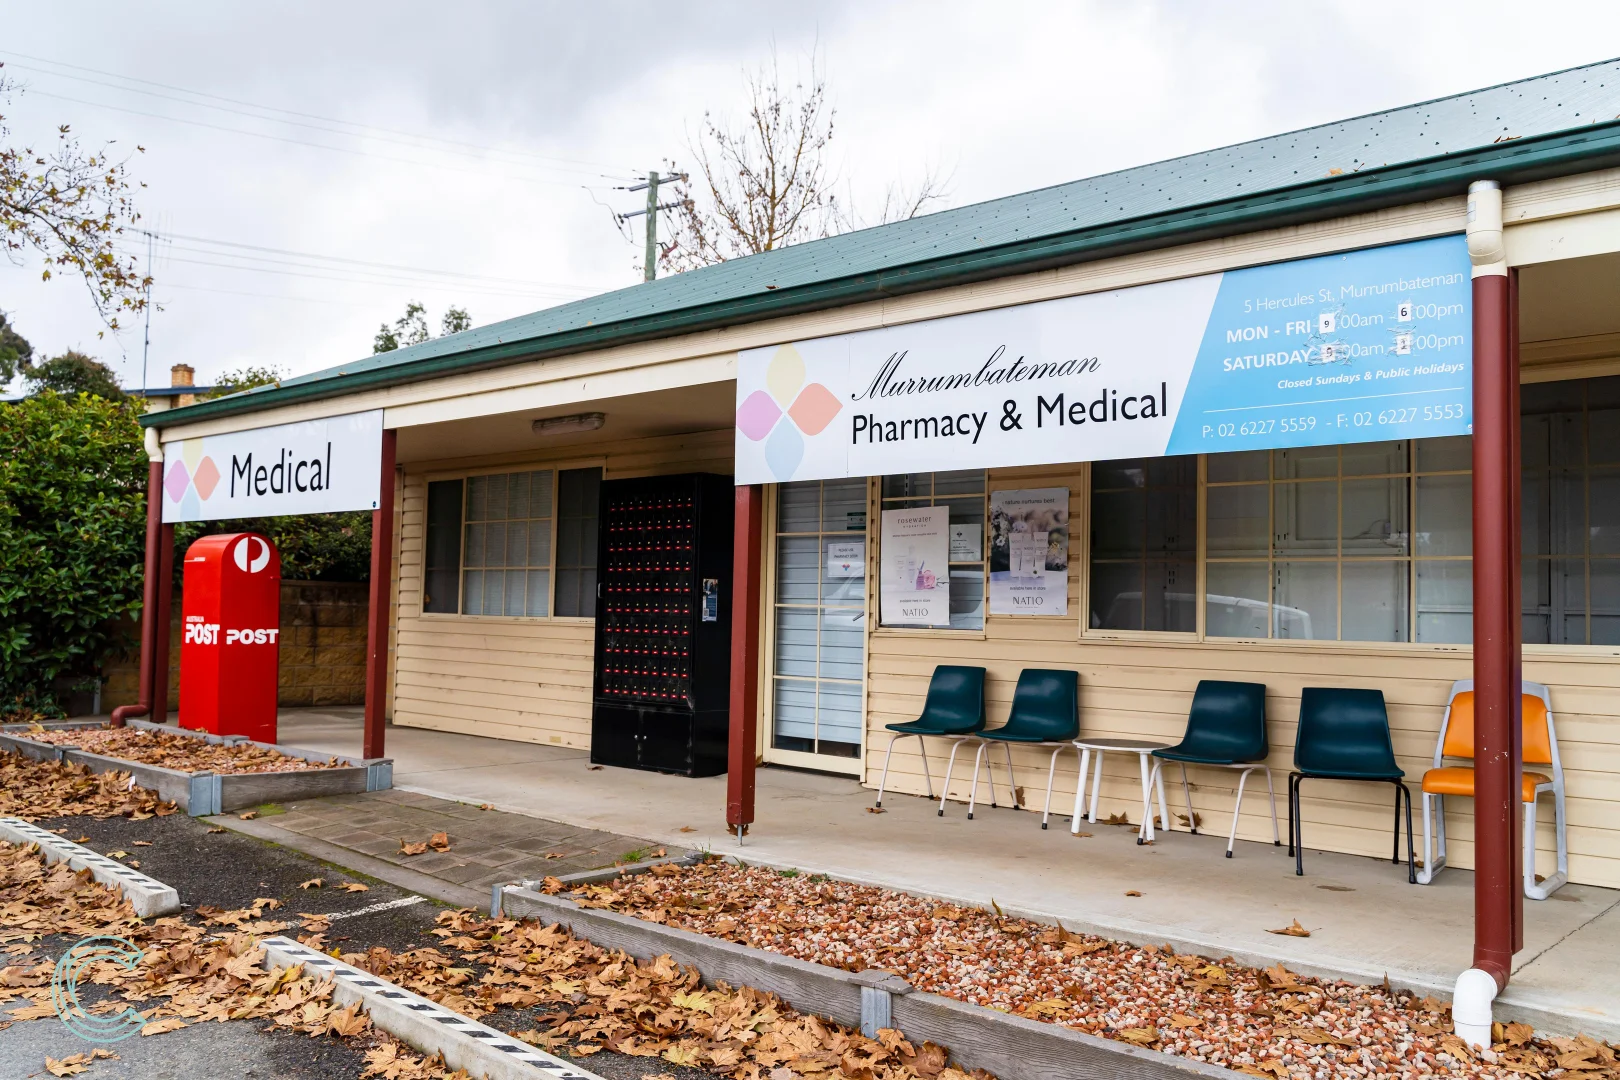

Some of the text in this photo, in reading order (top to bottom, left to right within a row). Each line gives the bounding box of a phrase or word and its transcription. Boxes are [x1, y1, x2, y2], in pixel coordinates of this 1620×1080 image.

[1244, 271, 1464, 313] 5 Hercules St, Murrumbateman
[1226, 325, 1269, 344] MON
[1285, 319, 1311, 336] FRI
[1223, 347, 1312, 372] SATURDAY
[851, 344, 1101, 402] Murrumbateman
[1277, 362, 1464, 390] Closed Sundays & Public Holidays
[852, 382, 1168, 445] Pharmacy & Medical
[1202, 425, 1214, 438] P:
[1218, 423, 1236, 437] 02
[1240, 420, 1275, 435] 6227
[1280, 416, 1317, 432] 5559
[1336, 414, 1349, 428] F:
[1353, 411, 1373, 427] 02
[1378, 407, 1417, 425] 6227
[1423, 403, 1464, 421] 5553
[230, 441, 332, 498] Medical
[897, 515, 932, 524] rosewater
[902, 607, 929, 617] NATIO
[1012, 596, 1044, 606] NATIO
[185, 623, 220, 645] POST
[226, 628, 279, 645] POST
